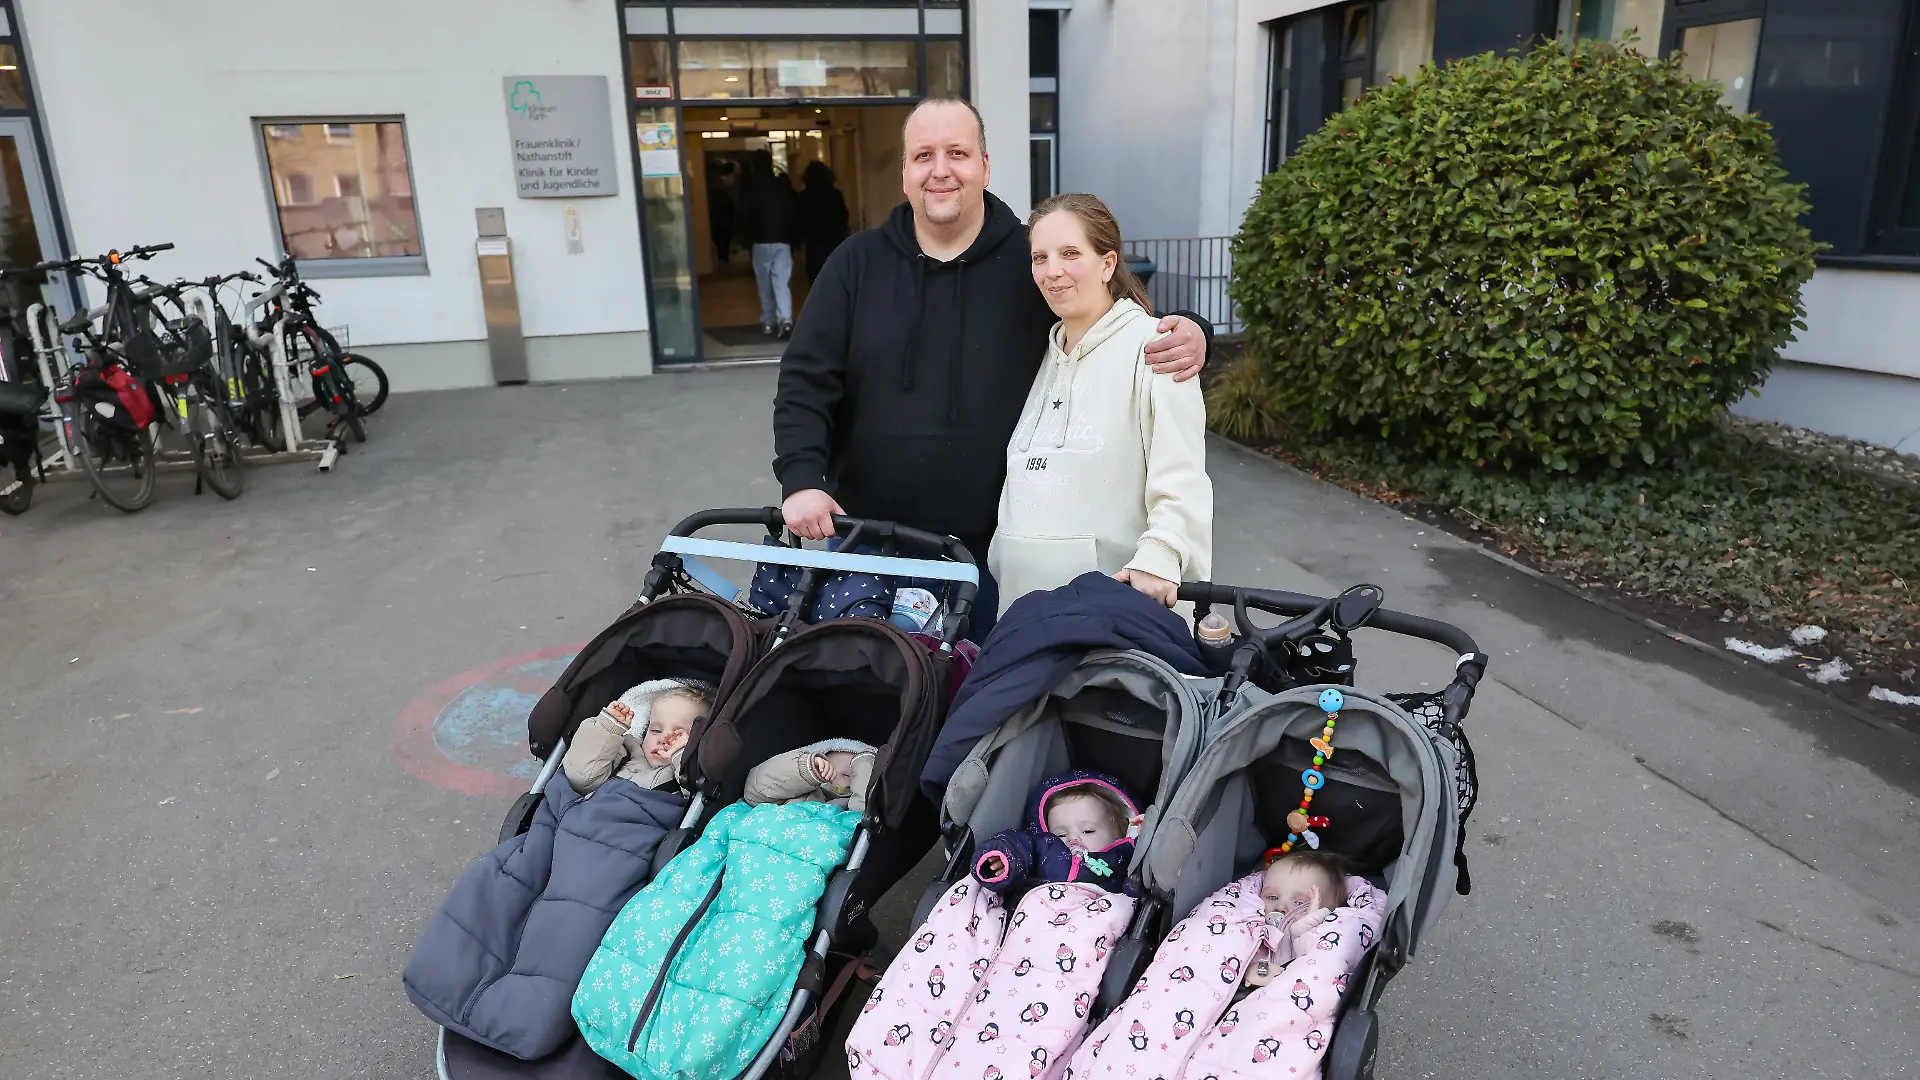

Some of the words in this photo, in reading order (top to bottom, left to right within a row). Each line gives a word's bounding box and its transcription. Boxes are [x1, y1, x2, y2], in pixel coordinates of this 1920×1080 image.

[517, 151, 572, 161] Nathanstift
[519, 168, 546, 177] Klinik
[549, 167, 563, 177] für
[566, 166, 599, 176] Kinder
[520, 180, 540, 190] und
[542, 179, 600, 192] Jugendliche
[1026, 458, 1048, 470] 1994
